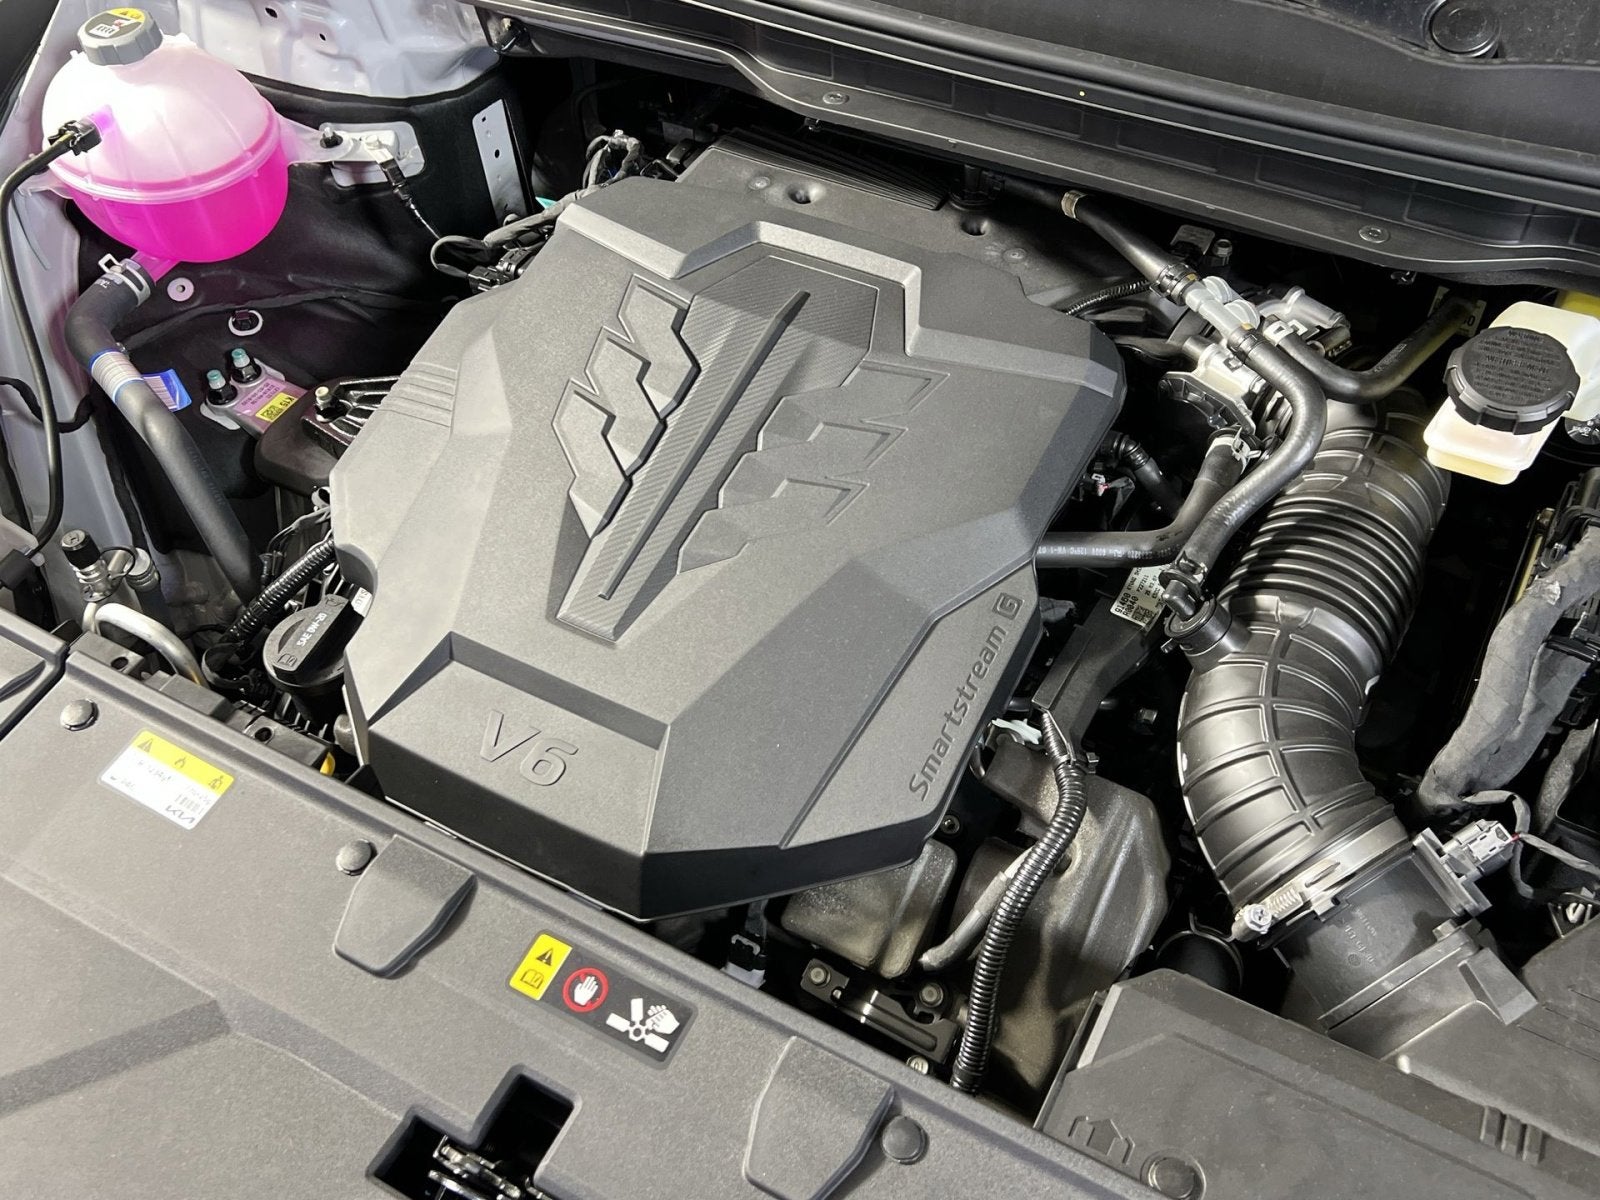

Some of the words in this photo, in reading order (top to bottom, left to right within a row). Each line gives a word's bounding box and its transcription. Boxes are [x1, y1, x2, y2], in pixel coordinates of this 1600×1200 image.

[296, 632, 313, 647] SAE
[909, 624, 1007, 802] Smartstream
[991, 592, 1025, 621] G
[479, 708, 580, 788] V6
